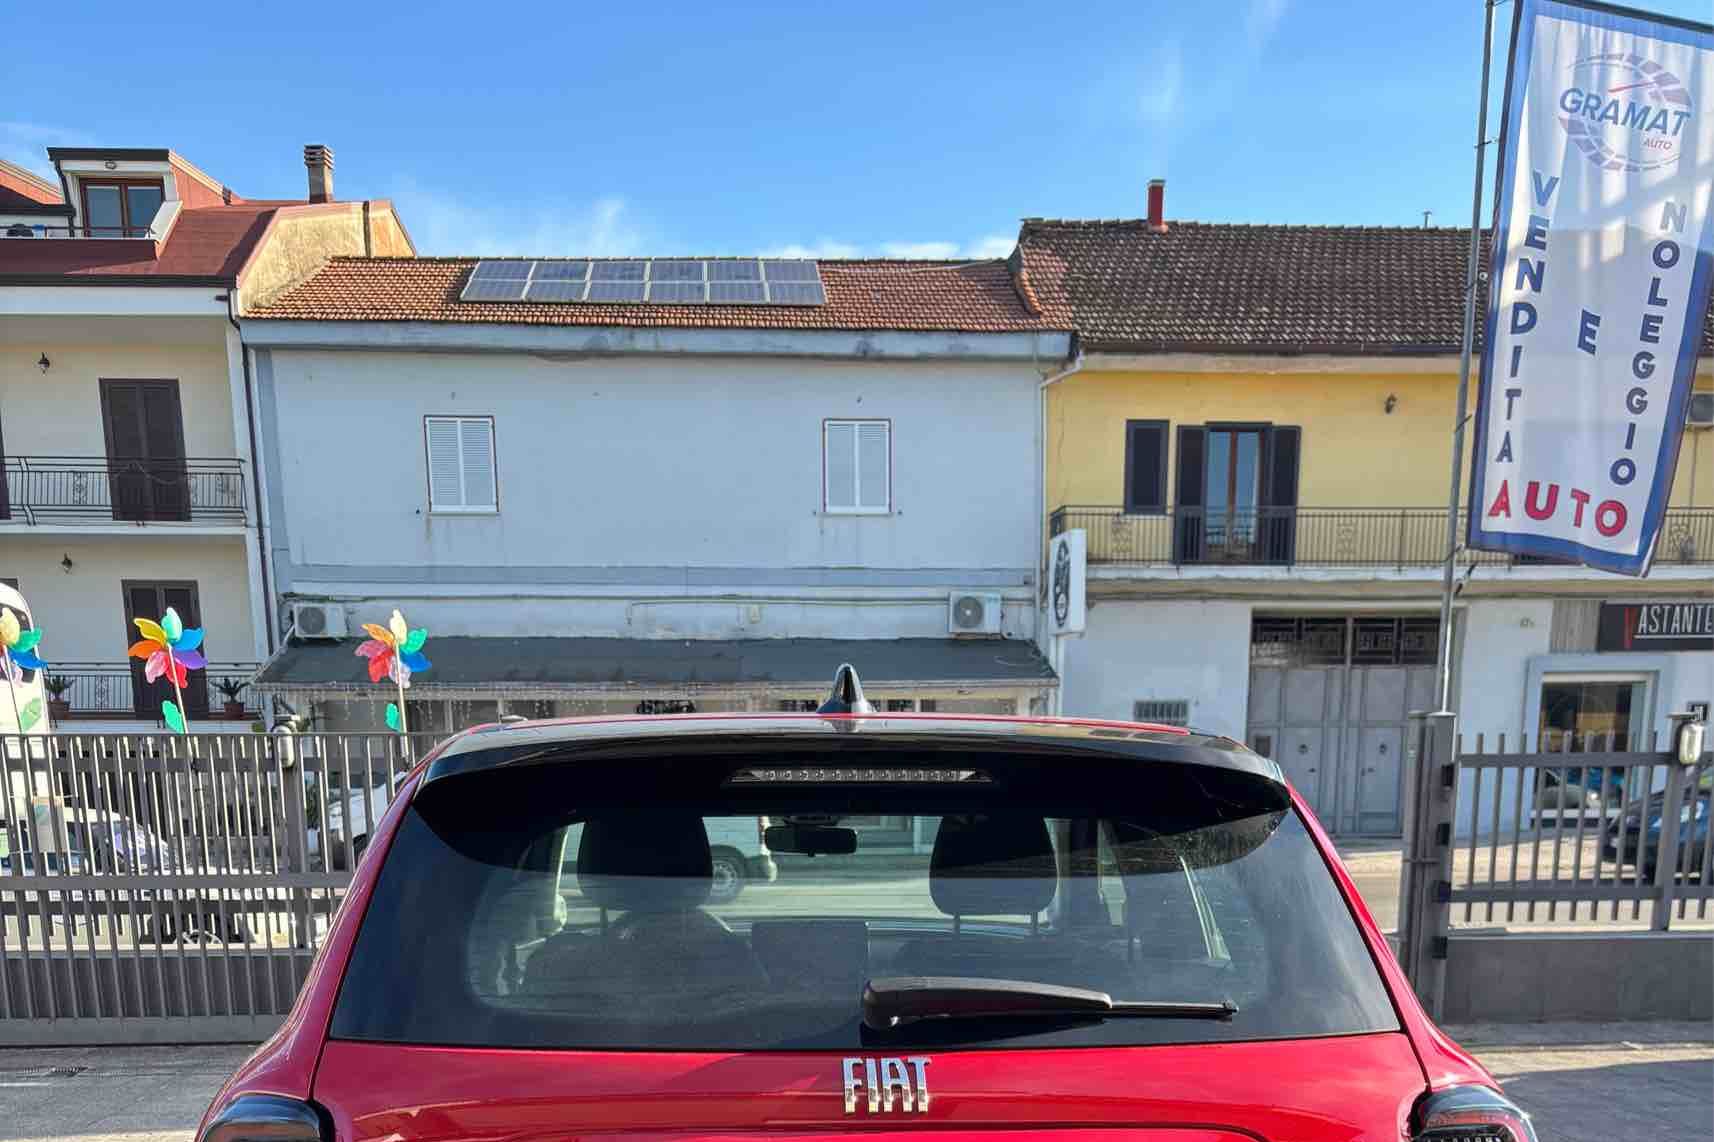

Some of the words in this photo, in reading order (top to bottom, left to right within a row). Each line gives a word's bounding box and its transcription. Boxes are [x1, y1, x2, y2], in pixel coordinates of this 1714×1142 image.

[1560, 88, 1691, 136] GRAMAT
[1644, 138, 1673, 150] AUTO
[1495, 169, 1559, 464] VENDITA
[1578, 308, 1601, 355] E
[1609, 201, 1687, 486] NOLEGGIO
[1488, 478, 1628, 538] AUTO
[843, 1055, 932, 1113] FIAT
